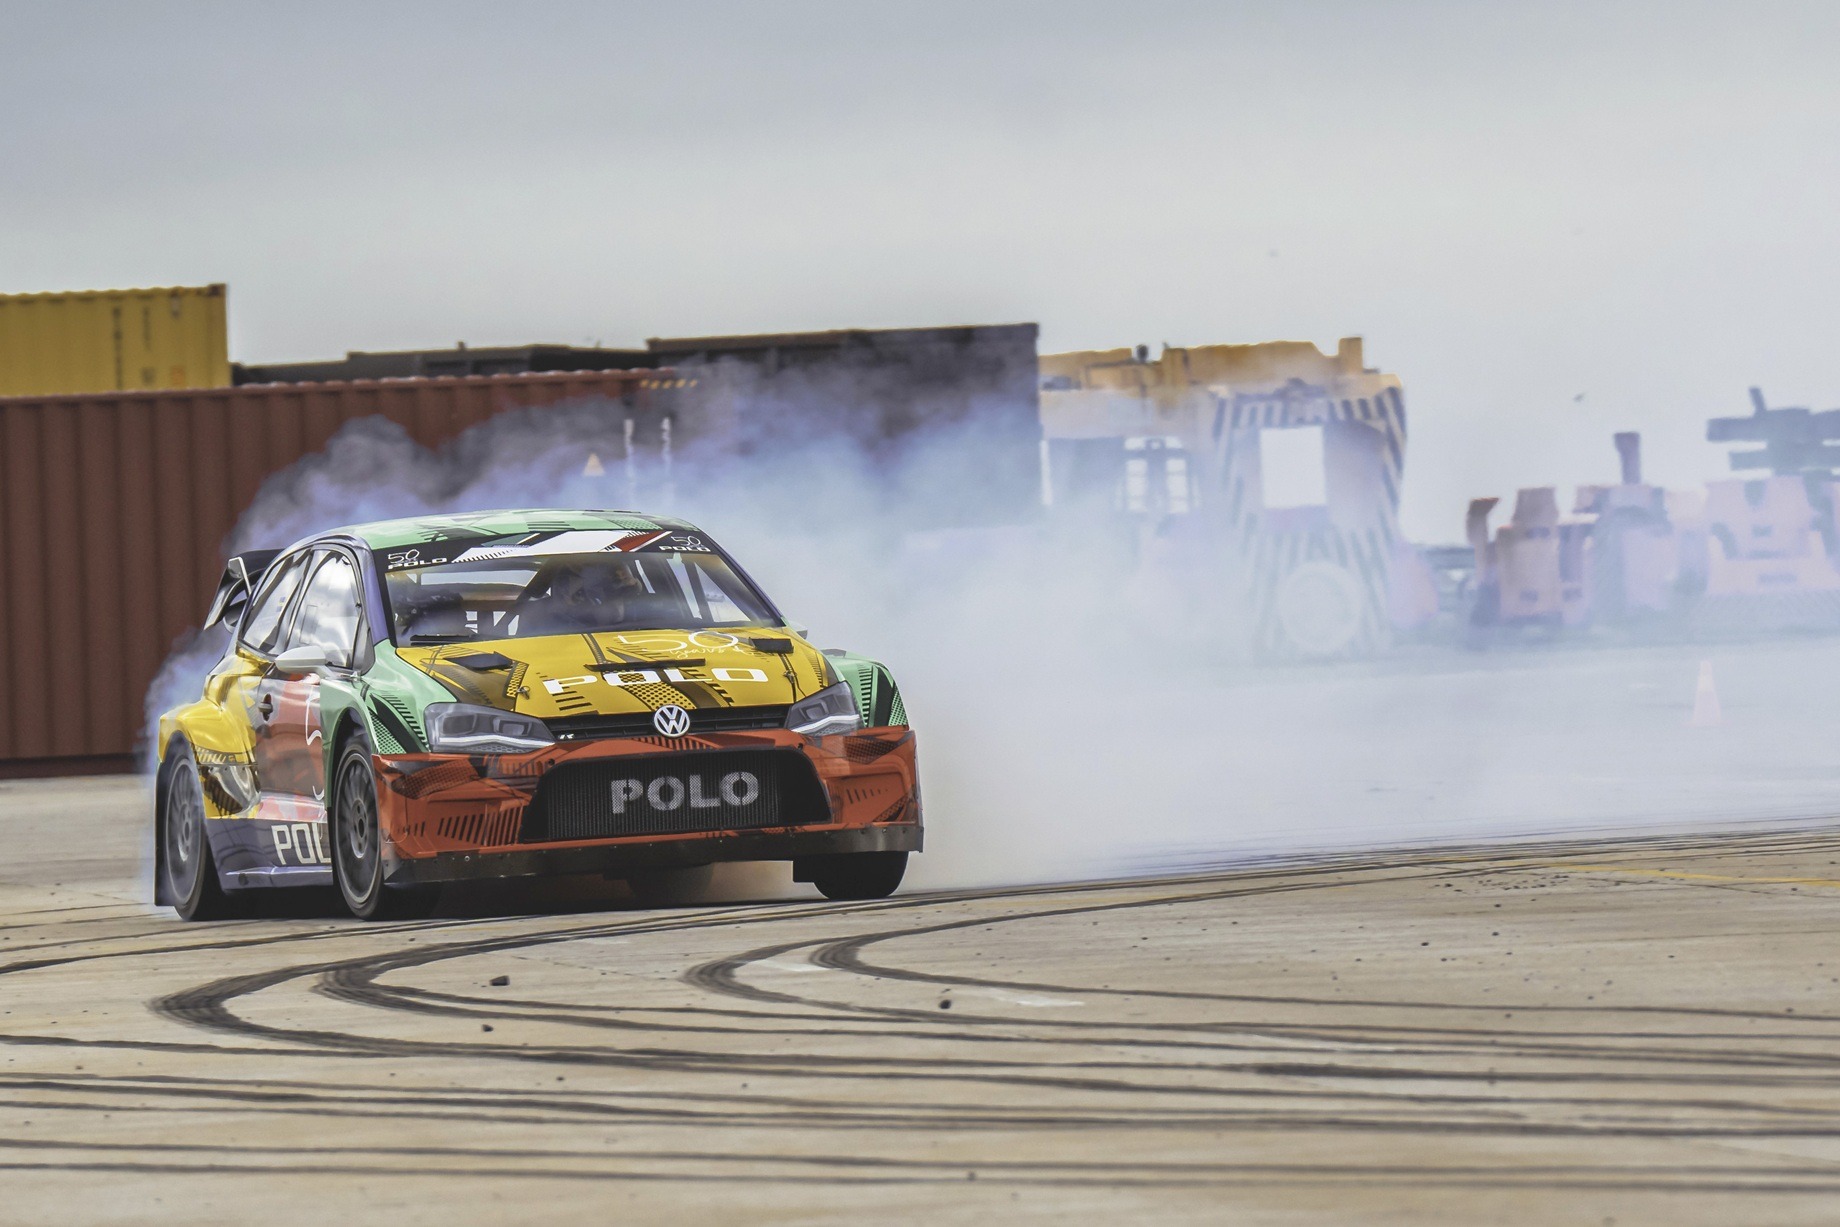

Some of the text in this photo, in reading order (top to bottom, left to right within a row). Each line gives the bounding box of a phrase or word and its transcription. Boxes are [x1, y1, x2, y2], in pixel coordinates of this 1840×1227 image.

[670, 535, 701, 546] 50
[387, 549, 420, 564] 50
[388, 558, 447, 570] POLO
[617, 631, 739, 652] 50
[542, 667, 769, 694] POLO
[654, 704, 691, 738] VW
[611, 771, 760, 814] POLO
